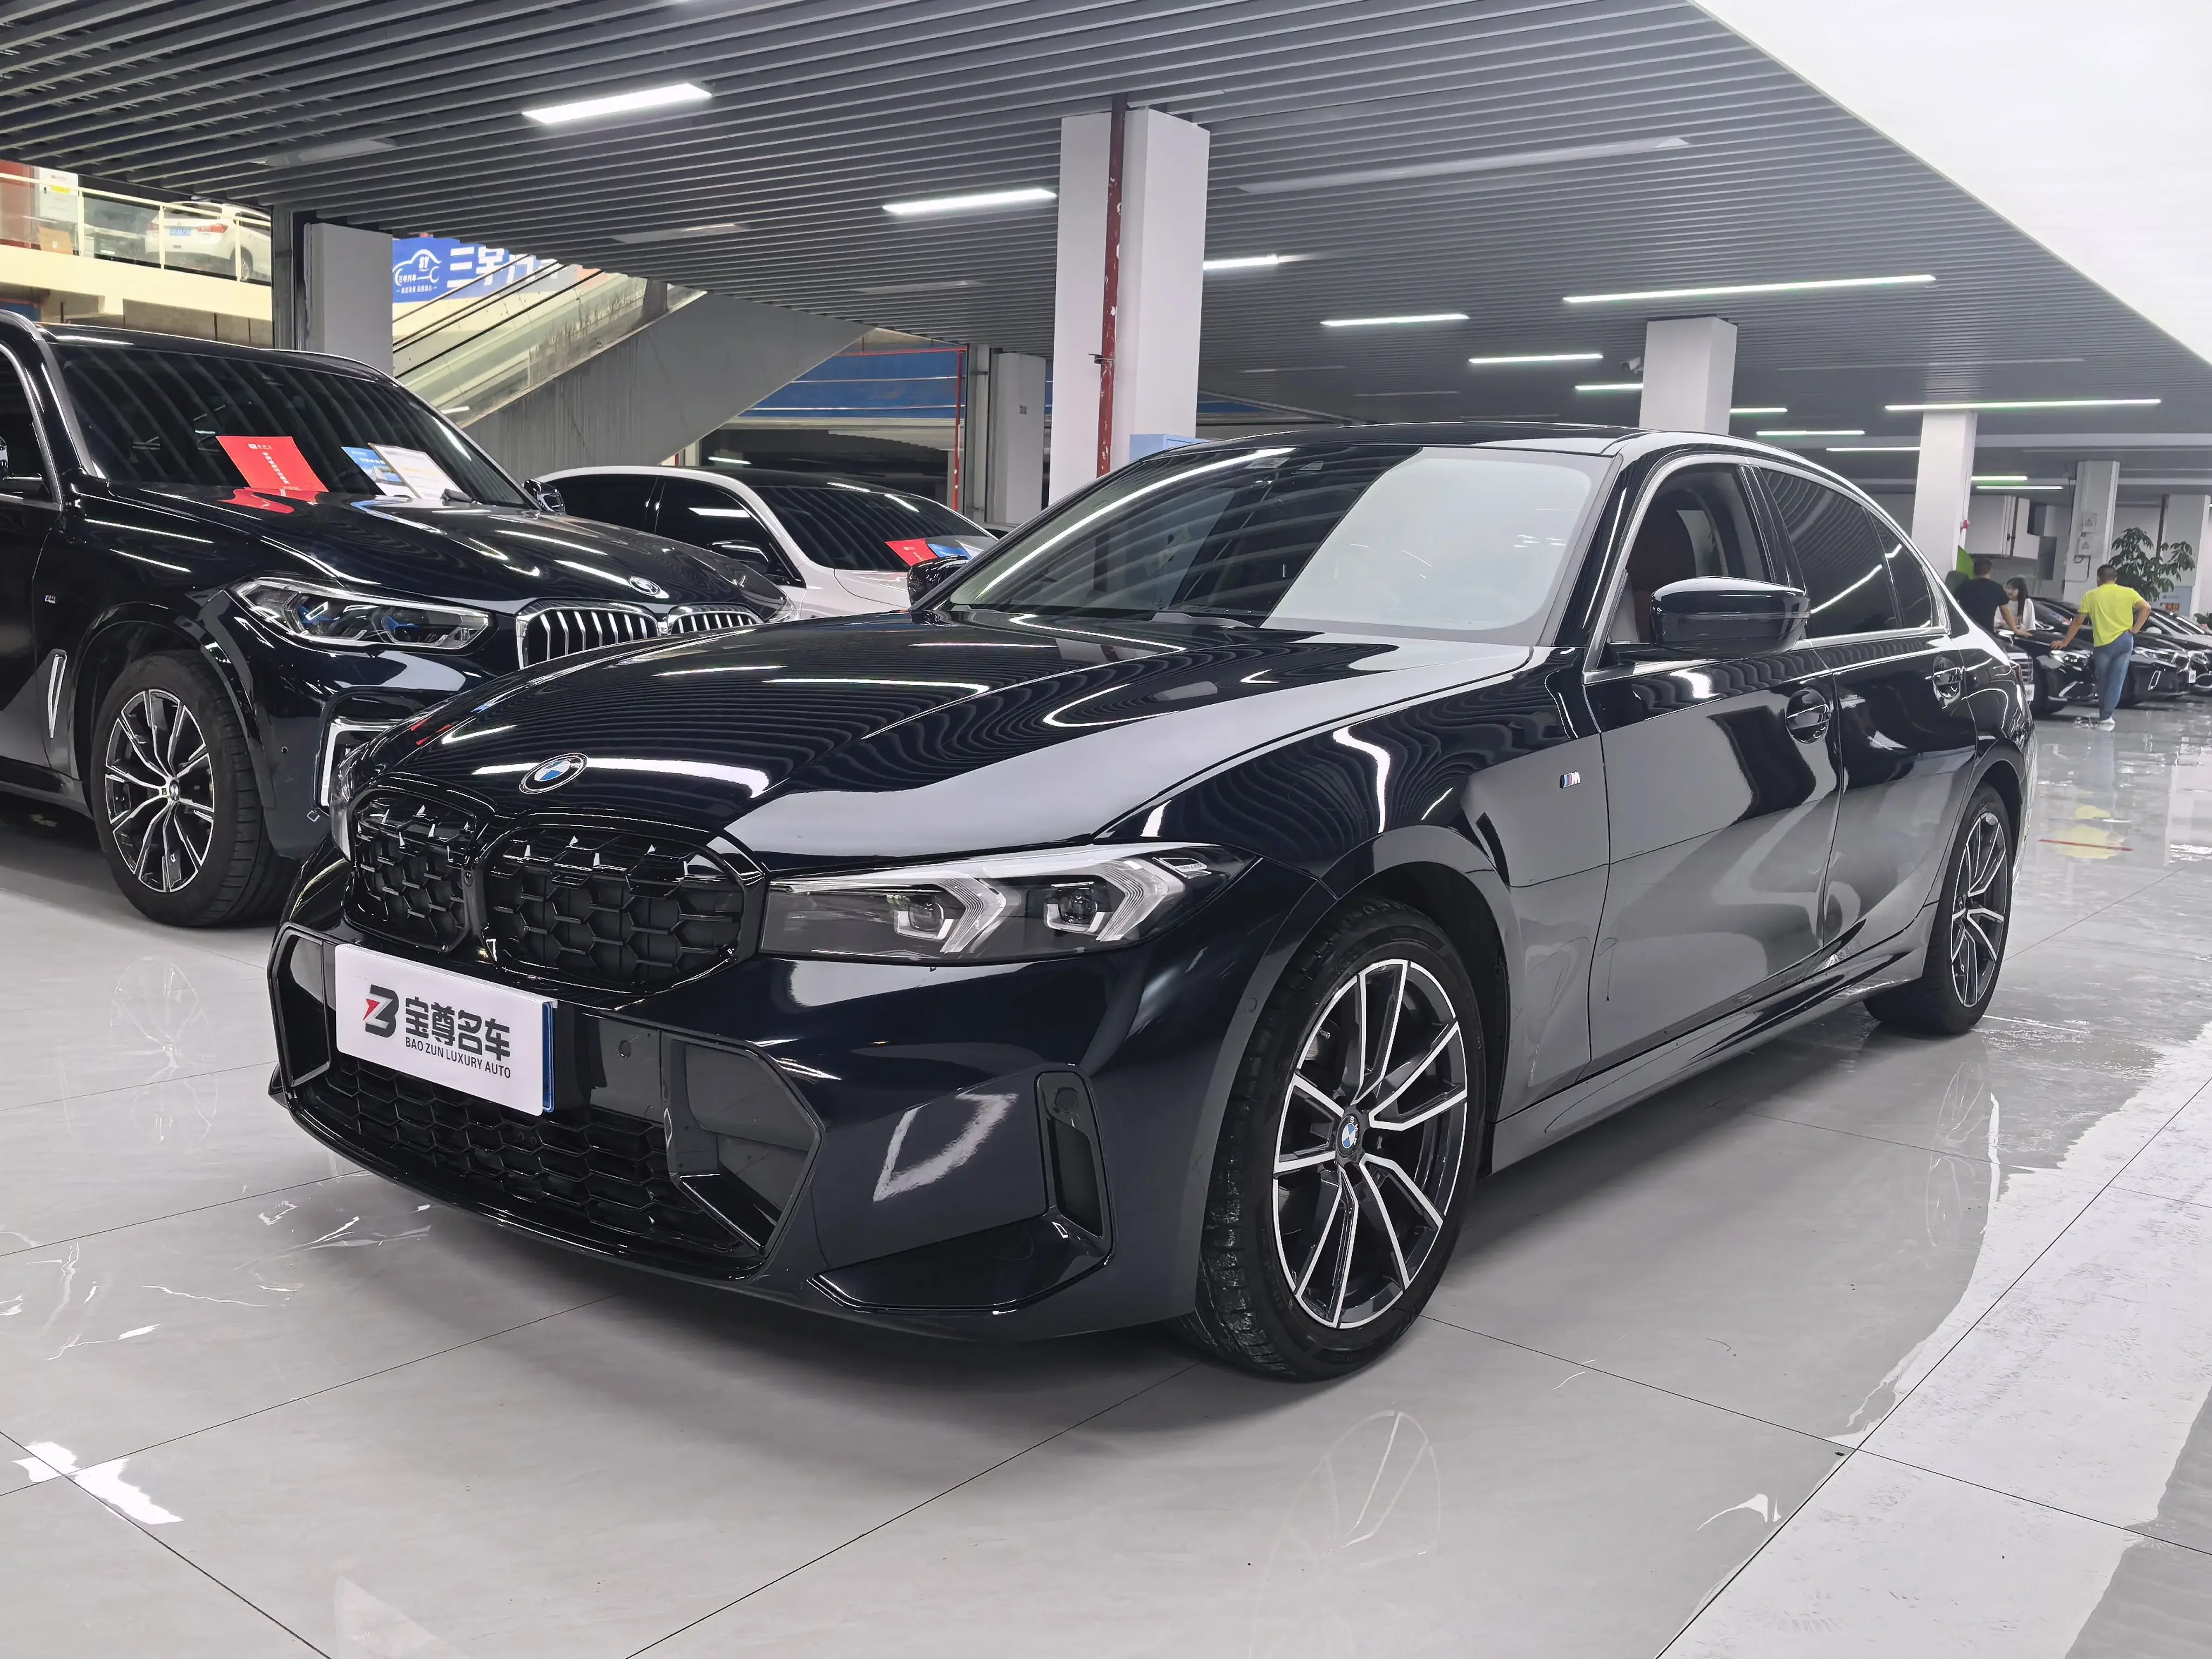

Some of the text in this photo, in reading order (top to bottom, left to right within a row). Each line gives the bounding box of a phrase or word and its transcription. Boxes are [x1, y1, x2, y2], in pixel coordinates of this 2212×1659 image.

[405, 996, 510, 1062] 宝尊名车
[406, 1036, 511, 1079] BAO ZUN LUXURY AUTO
